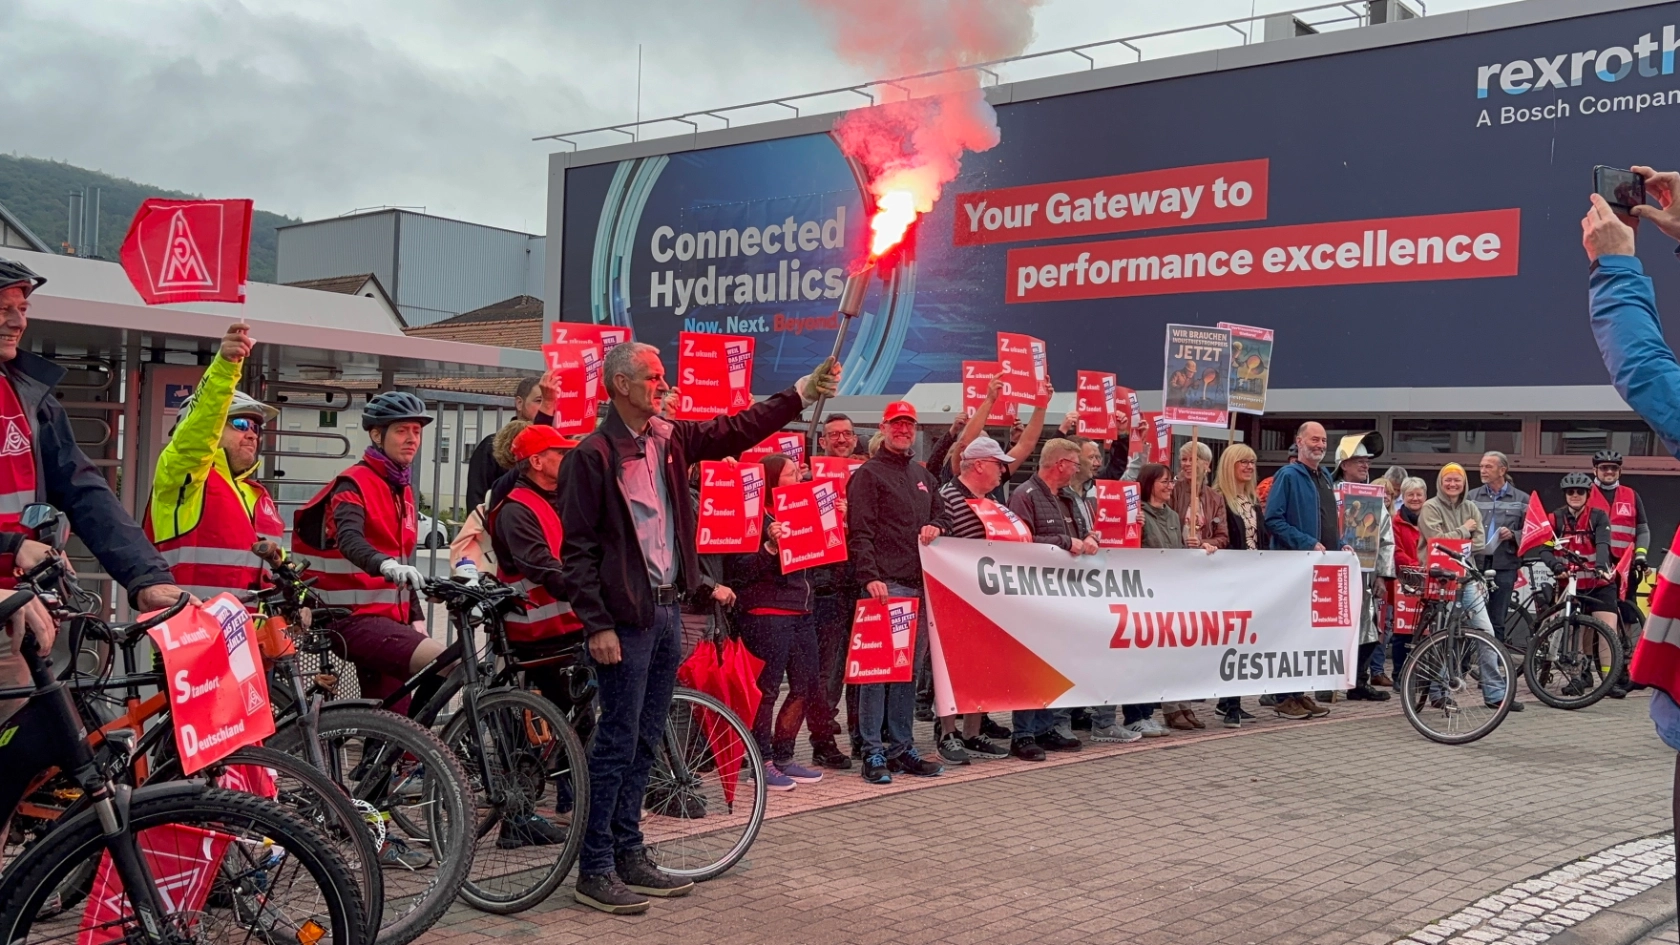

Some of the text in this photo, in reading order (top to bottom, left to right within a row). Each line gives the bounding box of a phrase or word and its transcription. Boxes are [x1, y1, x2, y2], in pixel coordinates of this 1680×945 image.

[1477, 25, 1680, 98] rexroth
[1476, 109, 1491, 127] A
[1501, 99, 1570, 125] Bosch
[964, 177, 1252, 232] Your Gateway to
[651, 206, 846, 263] Connected
[1017, 229, 1501, 296] performance excellence
[650, 258, 845, 315] Hydraulics
[684, 318, 722, 333] Now.
[727, 315, 769, 333] Next.
[1172, 329, 1227, 341] WIR BRAUCHEN
[683, 340, 717, 358] Zukunft
[1001, 338, 1028, 354] Zukunft
[1175, 345, 1222, 361] JETZT
[549, 351, 579, 369] Zukunft
[1002, 360, 1030, 378] Standort
[683, 367, 719, 387] Standort
[966, 366, 994, 379] Zukunft
[1002, 382, 1036, 400] Deutschland
[681, 396, 728, 414] Deutschland
[704, 469, 735, 487] Zukunft
[816, 462, 845, 478] Zukunft
[703, 498, 735, 516] Standort
[777, 493, 809, 511] Zukunft
[700, 527, 742, 545] Deutschland
[780, 521, 813, 538] Standort
[782, 548, 825, 566] Deutschland
[856, 606, 881, 623] Zukunft
[852, 633, 882, 650] Standort
[849, 661, 890, 677] Deutschland
[174, 669, 220, 704] Standort
[180, 719, 245, 758] Deutschland
